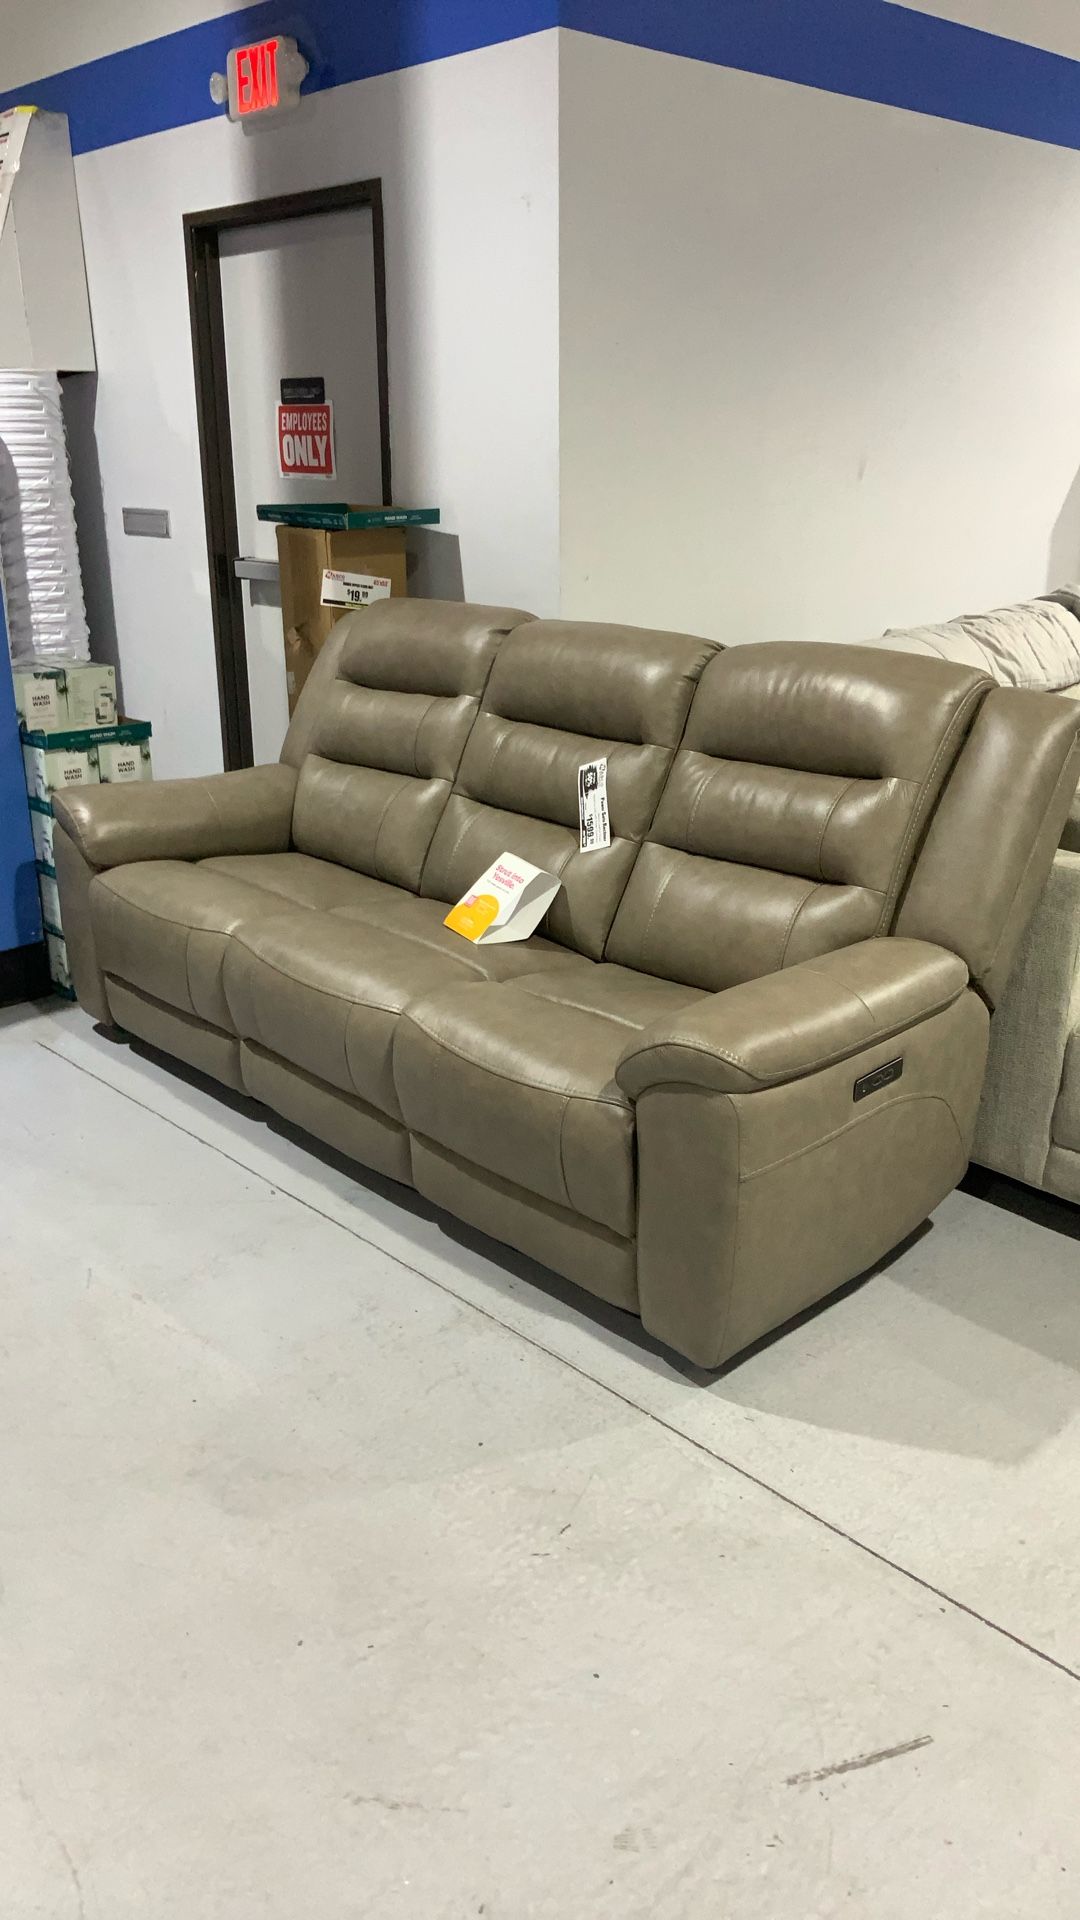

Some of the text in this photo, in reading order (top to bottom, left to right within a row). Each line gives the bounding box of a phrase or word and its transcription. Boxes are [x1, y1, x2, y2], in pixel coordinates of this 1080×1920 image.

[236, 39, 278, 114] EXIT
[281, 412, 328, 431] EMPLOYEES
[282, 434, 328, 467] ONLY
[496, 864, 525, 884] Strut into
